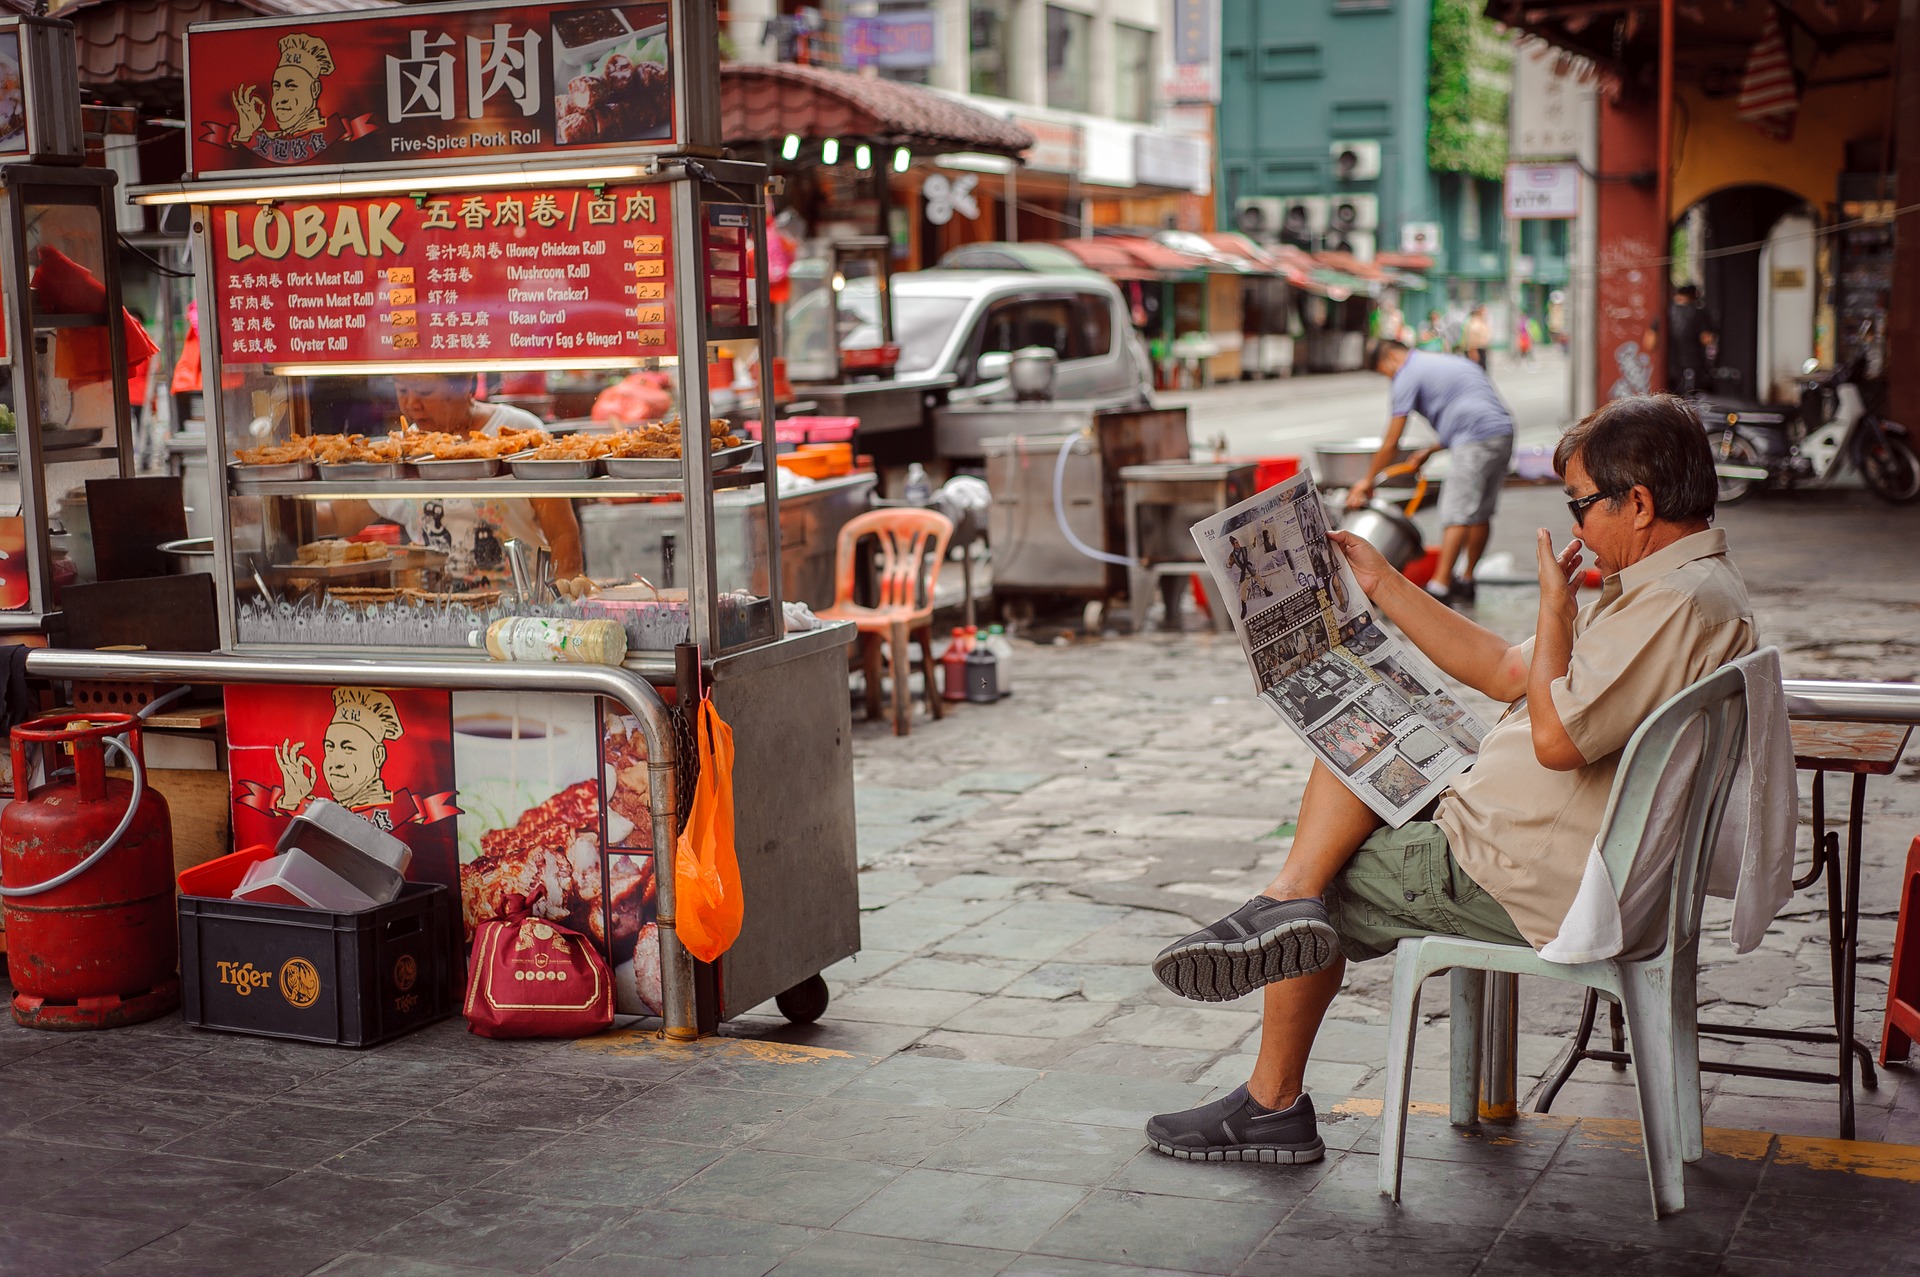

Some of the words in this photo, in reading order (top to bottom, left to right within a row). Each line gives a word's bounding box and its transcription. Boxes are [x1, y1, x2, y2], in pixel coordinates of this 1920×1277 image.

[284, 53, 302, 64] 文记
[386, 23, 542, 123] 卤肉
[391, 135, 468, 152] Five-Spice
[472, 132, 506, 147] Pork
[511, 129, 540, 144] Roll
[225, 202, 405, 261] LOBAK
[426, 242, 502, 261] 蜜汁鸡肉卷
[506, 243, 539, 259] (Honey
[542, 242, 580, 256] Chicken
[583, 240, 605, 255] Roll)
[624, 240, 635, 248] RM
[507, 265, 566, 281] (Mushroom
[567, 264, 590, 278] Roll)
[624, 262, 637, 271] RM
[229, 273, 282, 288] 五香肉卷
[287, 272, 313, 286] (Pork
[315, 272, 341, 285] Meat
[343, 271, 363, 284] Roll)
[378, 270, 389, 280] RM
[427, 267, 473, 283] 冬菇卷
[379, 292, 390, 300] RM
[428, 290, 458, 304] 虾饼
[508, 288, 544, 302] (Prawn
[546, 286, 588, 302] Cracker)
[625, 286, 637, 294] RM
[230, 295, 274, 310] 虾肉卷
[288, 294, 323, 308] (Prawn
[326, 293, 352, 307] Meat
[354, 292, 374, 306] Roll)
[380, 314, 392, 322] RM
[430, 310, 489, 327] 五香豆腐
[509, 310, 537, 324] (Bean
[540, 309, 566, 324] Curd)
[625, 307, 638, 317] RM
[232, 316, 275, 332] 蟹肉卷
[290, 316, 315, 329] (Crab
[318, 315, 343, 329] Meat
[345, 314, 366, 328] Roll)
[381, 336, 393, 344] RM
[431, 333, 491, 349] 皮蛋酸姜
[510, 333, 553, 348] (Century
[556, 332, 573, 348] Egg
[576, 332, 584, 345] &
[587, 331, 622, 347] Ginger)
[626, 331, 639, 340] RM
[291, 338, 325, 353] (Oyster
[328, 336, 347, 350] Roll)
[340, 707, 361, 721] 文记
[216, 961, 273, 996] Tiger
[394, 993, 419, 1013] Tiger
